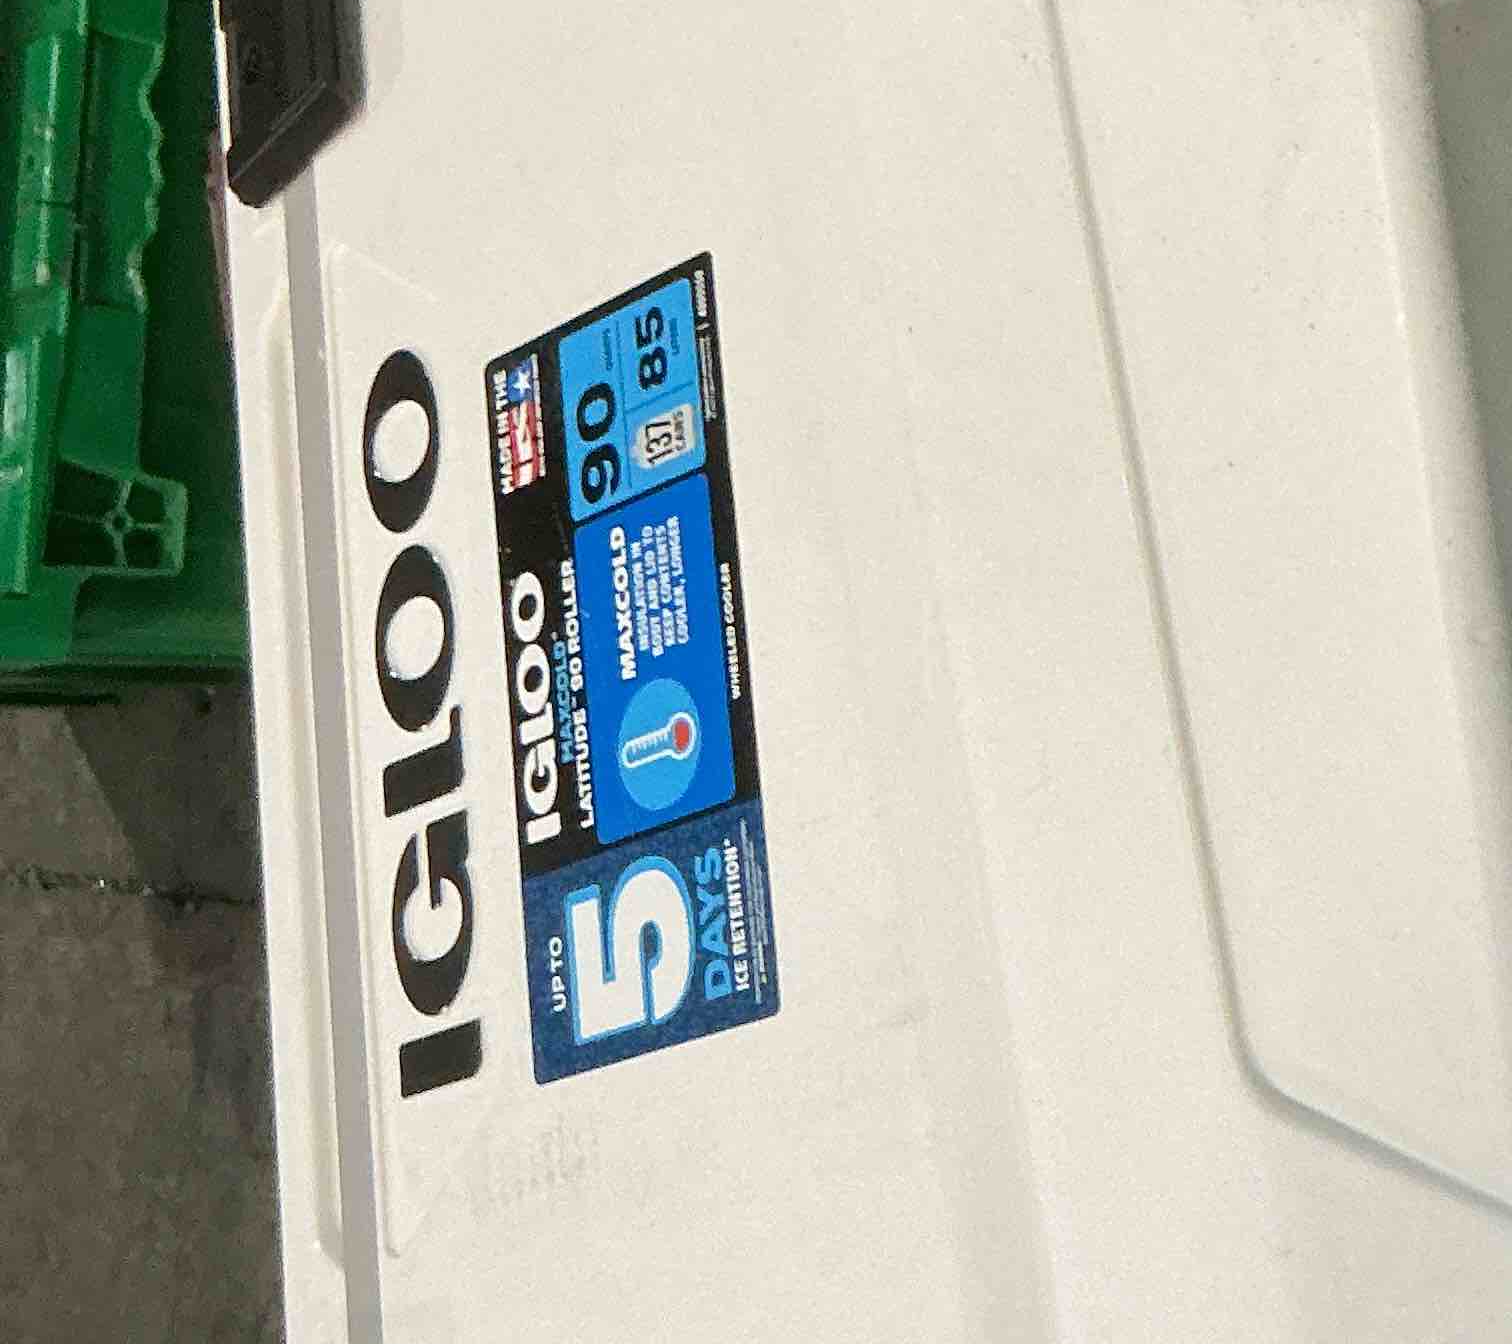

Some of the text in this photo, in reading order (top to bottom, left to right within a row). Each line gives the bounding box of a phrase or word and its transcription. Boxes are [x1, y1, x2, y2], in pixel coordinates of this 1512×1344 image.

[635, 306, 669, 391] 85
[492, 368, 514, 495] MADE IN THE
[576, 382, 621, 504] 90
[645, 420, 673, 465] 137
[561, 559, 582, 654] ROLLER
[609, 526, 637, 680] MAXCOLD
[719, 561, 742, 700] WHEELED COOLER
[363, 348, 482, 1097] IGLOO
[511, 571, 561, 843] IGLOO
[549, 937, 567, 1013] UP TO
[564, 856, 696, 1044] 5
[694, 847, 733, 1000] DAYS
[732, 959, 750, 991] ICE
